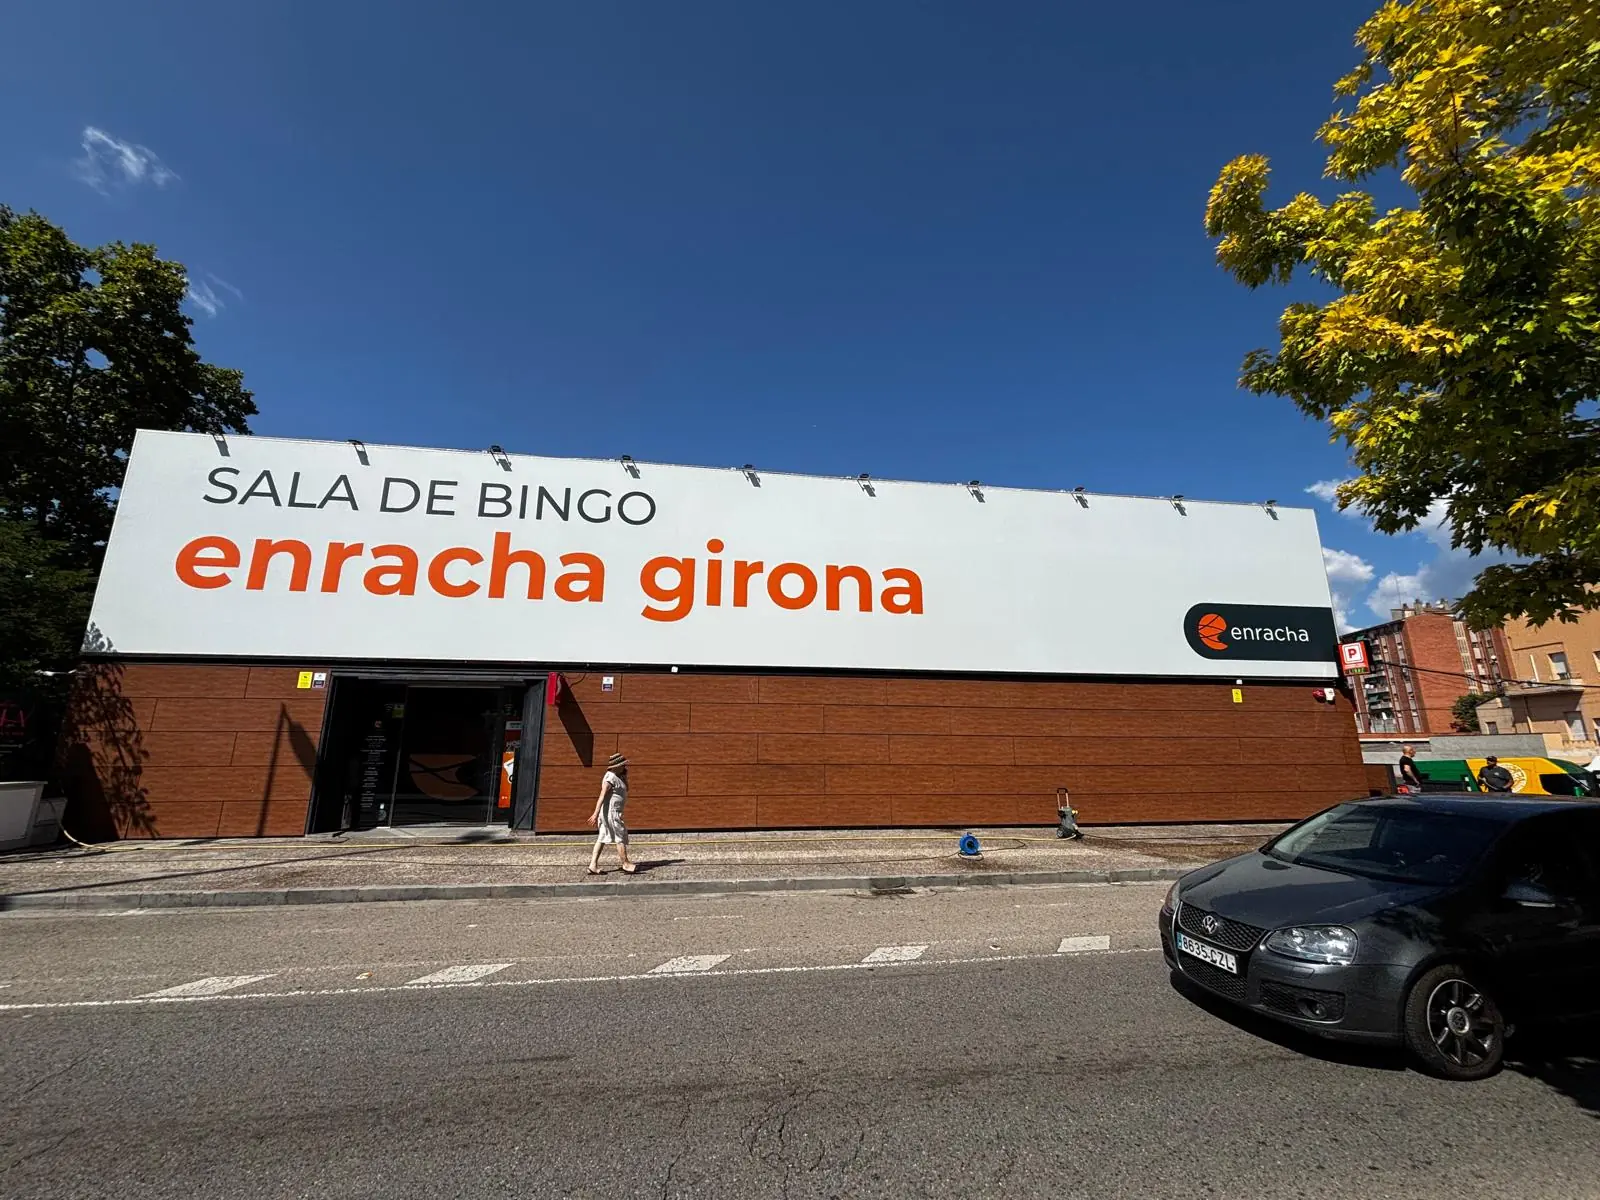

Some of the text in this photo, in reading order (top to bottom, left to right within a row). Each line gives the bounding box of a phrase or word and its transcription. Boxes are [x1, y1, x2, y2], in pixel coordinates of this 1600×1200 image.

[202, 466, 657, 526] SALA DE BINGO
[175, 531, 924, 622] enracha girona
[1230, 626, 1309, 642] enracha
[1348, 648, 1357, 658] P
